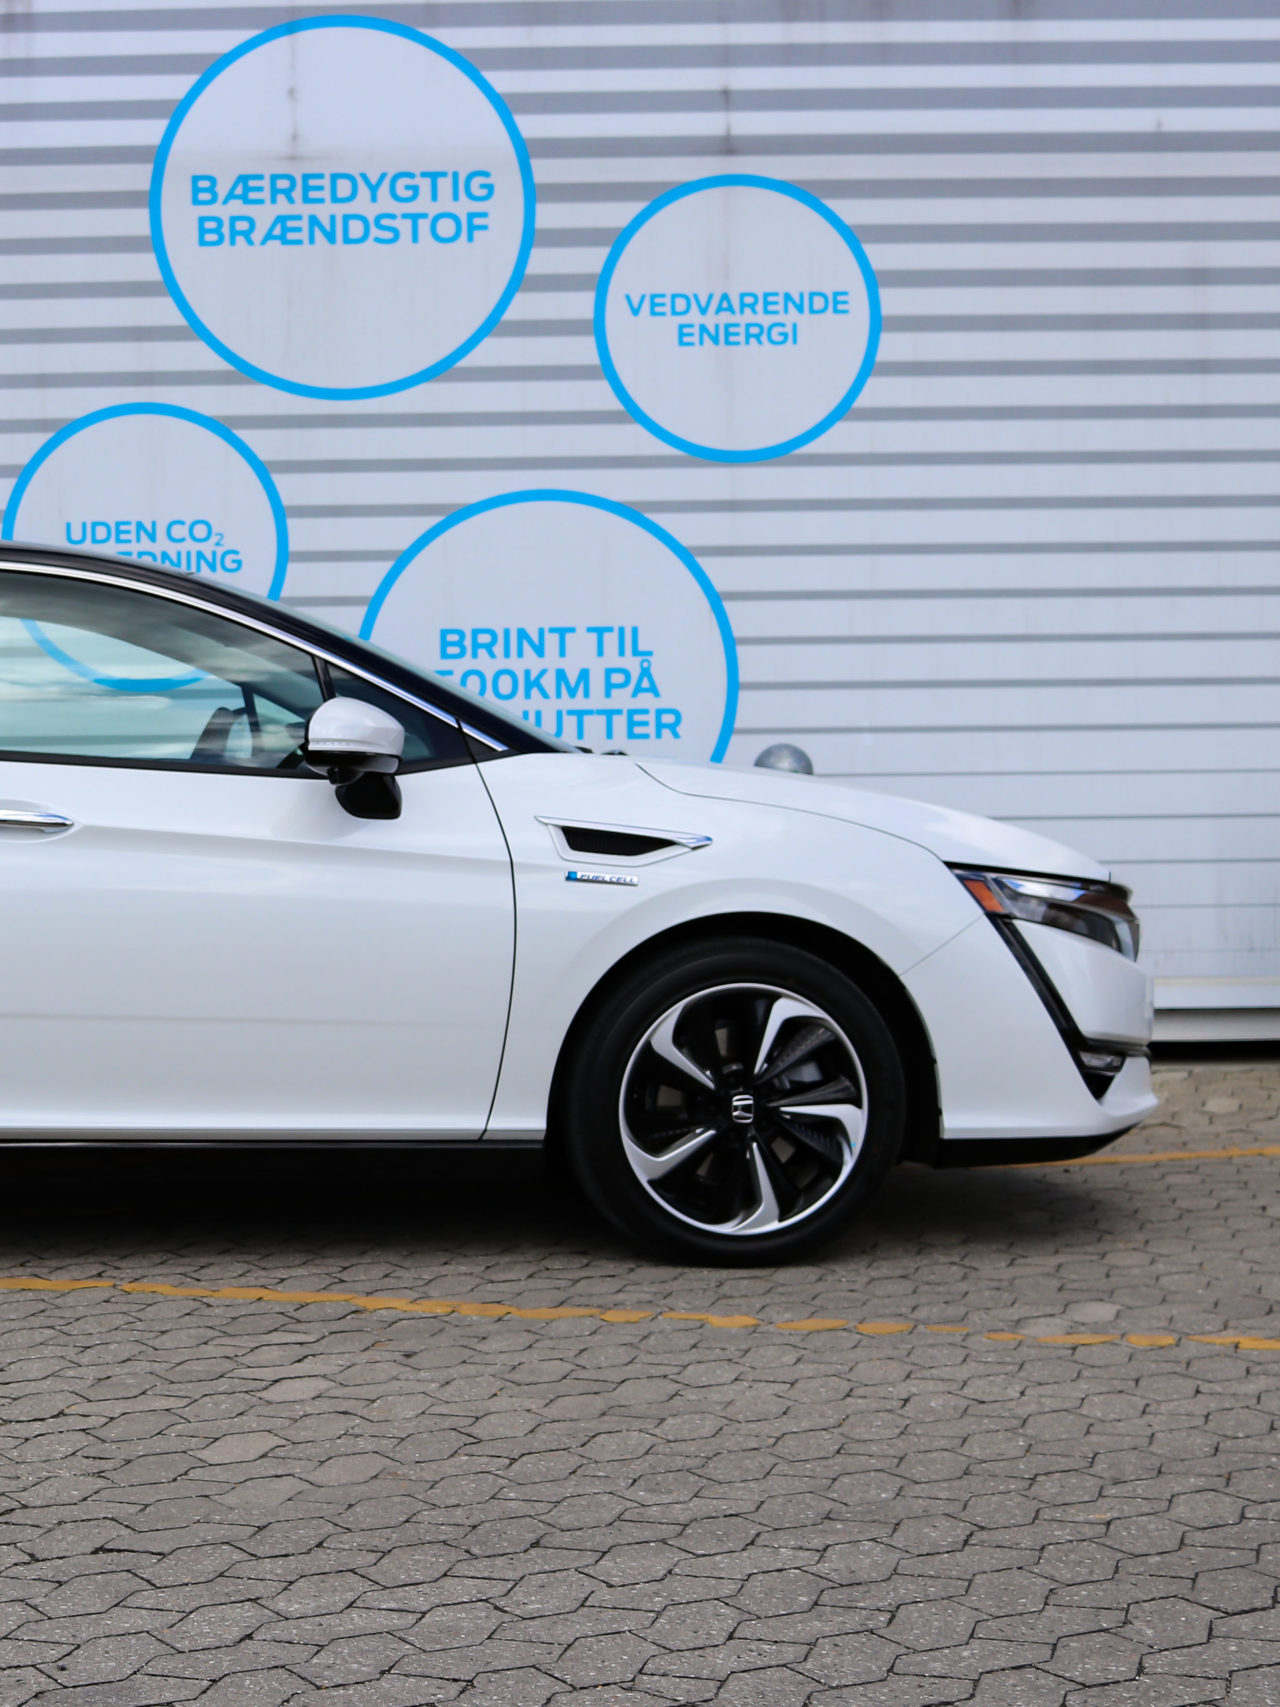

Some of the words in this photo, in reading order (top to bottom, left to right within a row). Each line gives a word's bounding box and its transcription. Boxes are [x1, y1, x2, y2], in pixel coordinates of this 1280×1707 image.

[190, 170, 495, 206] BÆREDYGTIG
[197, 212, 489, 247] BRÆNDSTOF
[625, 291, 850, 317] VEDVARENDE
[677, 322, 798, 347] ENERGI
[65, 520, 157, 545] UDEN
[439, 627, 576, 660] BRINT
[586, 626, 654, 658] TIL
[434, 667, 591, 701] 00KM
[604, 658, 661, 699] PÅ
[522, 708, 682, 741] UTTER
